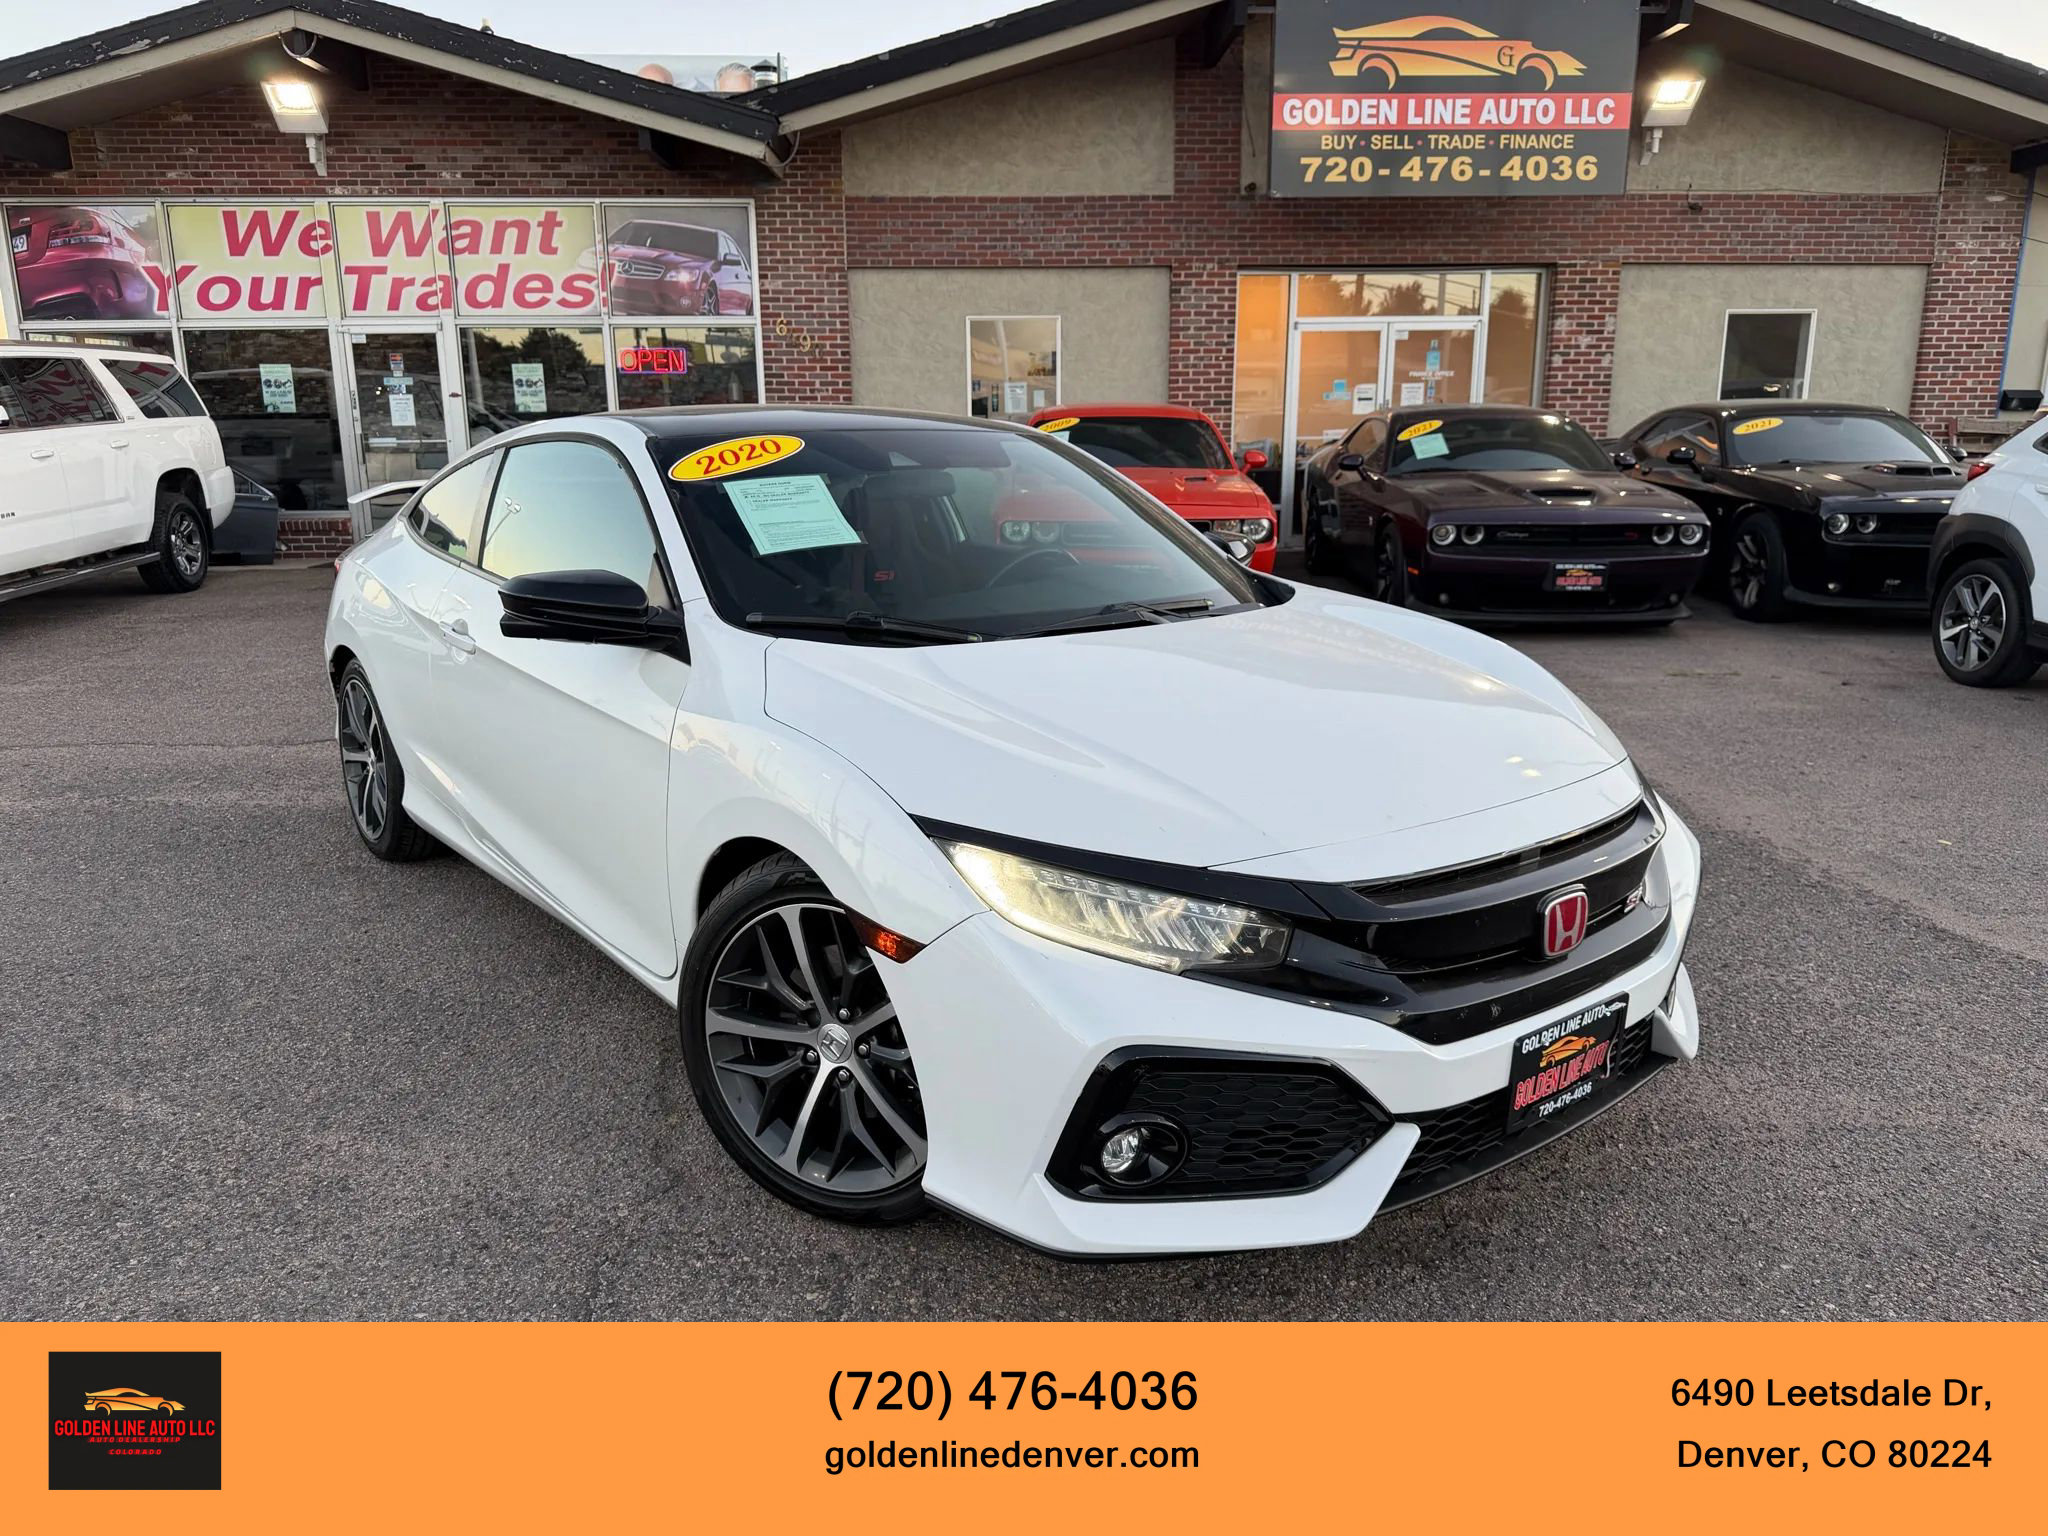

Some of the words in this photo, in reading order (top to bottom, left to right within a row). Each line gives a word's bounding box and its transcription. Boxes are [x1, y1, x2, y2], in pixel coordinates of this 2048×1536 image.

[1282, 98, 1398, 126] GOLDEN
[1407, 98, 1471, 125] LINE
[1478, 98, 1556, 125] AUTO
[1564, 97, 1615, 125] LLC
[1321, 135, 1358, 150] BUY
[1371, 134, 1414, 150] SELL
[1428, 134, 1486, 150] TRADE
[1500, 134, 1574, 150] FINANCE
[222, 210, 333, 257] We
[365, 208, 563, 257] Want
[141, 264, 323, 312] Your
[620, 349, 685, 372] OPEN
[696, 439, 782, 475] 2020
[1522, 1025, 1560, 1054] GOLDEN
[1561, 1014, 1582, 1036] LINE
[1581, 1004, 1606, 1024] AUTO
[1514, 1065, 1561, 1110] GOLDEN
[1559, 1053, 1585, 1089] LINE
[1539, 1082, 1592, 1117] 720-476-4036
